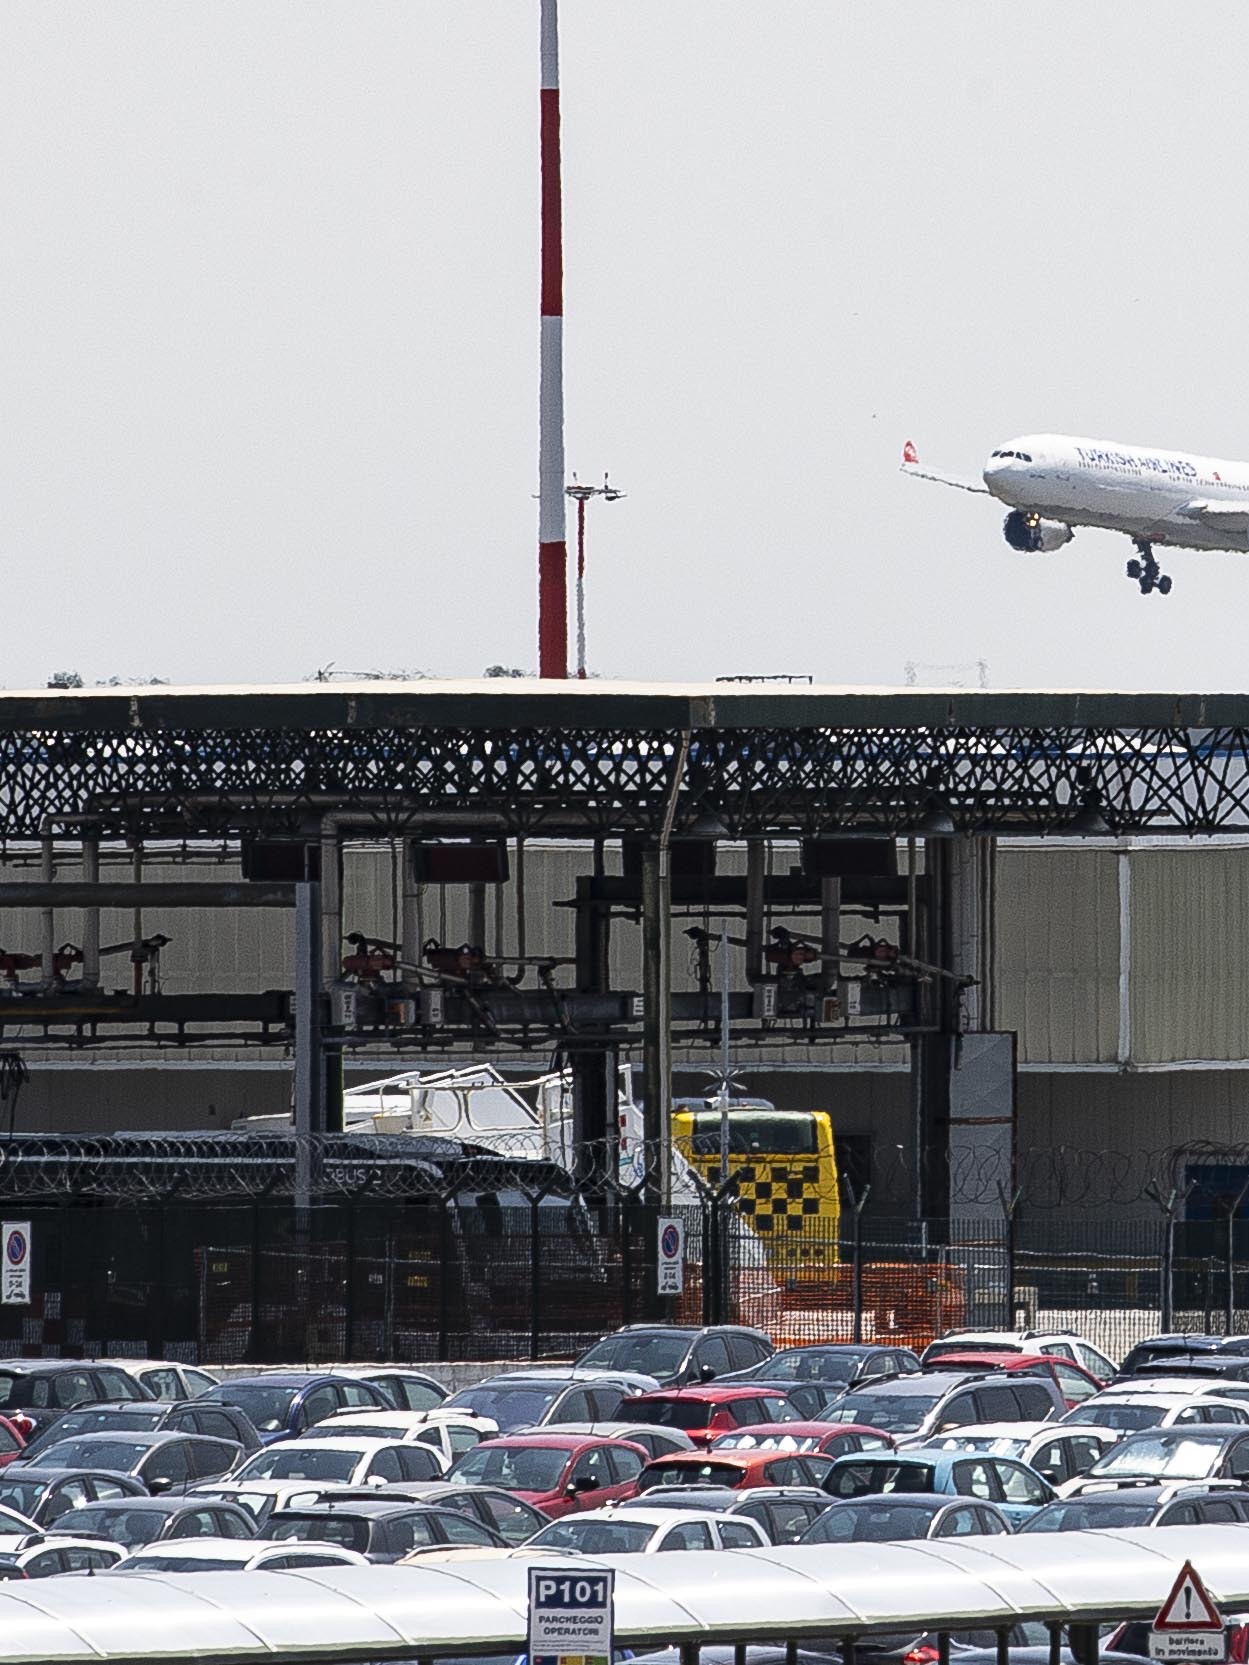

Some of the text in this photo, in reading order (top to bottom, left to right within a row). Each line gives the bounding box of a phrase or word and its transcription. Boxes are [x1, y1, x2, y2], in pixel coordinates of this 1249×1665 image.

[1075, 447, 1197, 477] TURKISH AIRLINES
[539, 1580, 604, 1602] P101
[538, 1615, 604, 1625] PARCHEGGIO
[543, 1626, 599, 1636] OPERATORI
[1168, 1636, 1205, 1646] barriera
